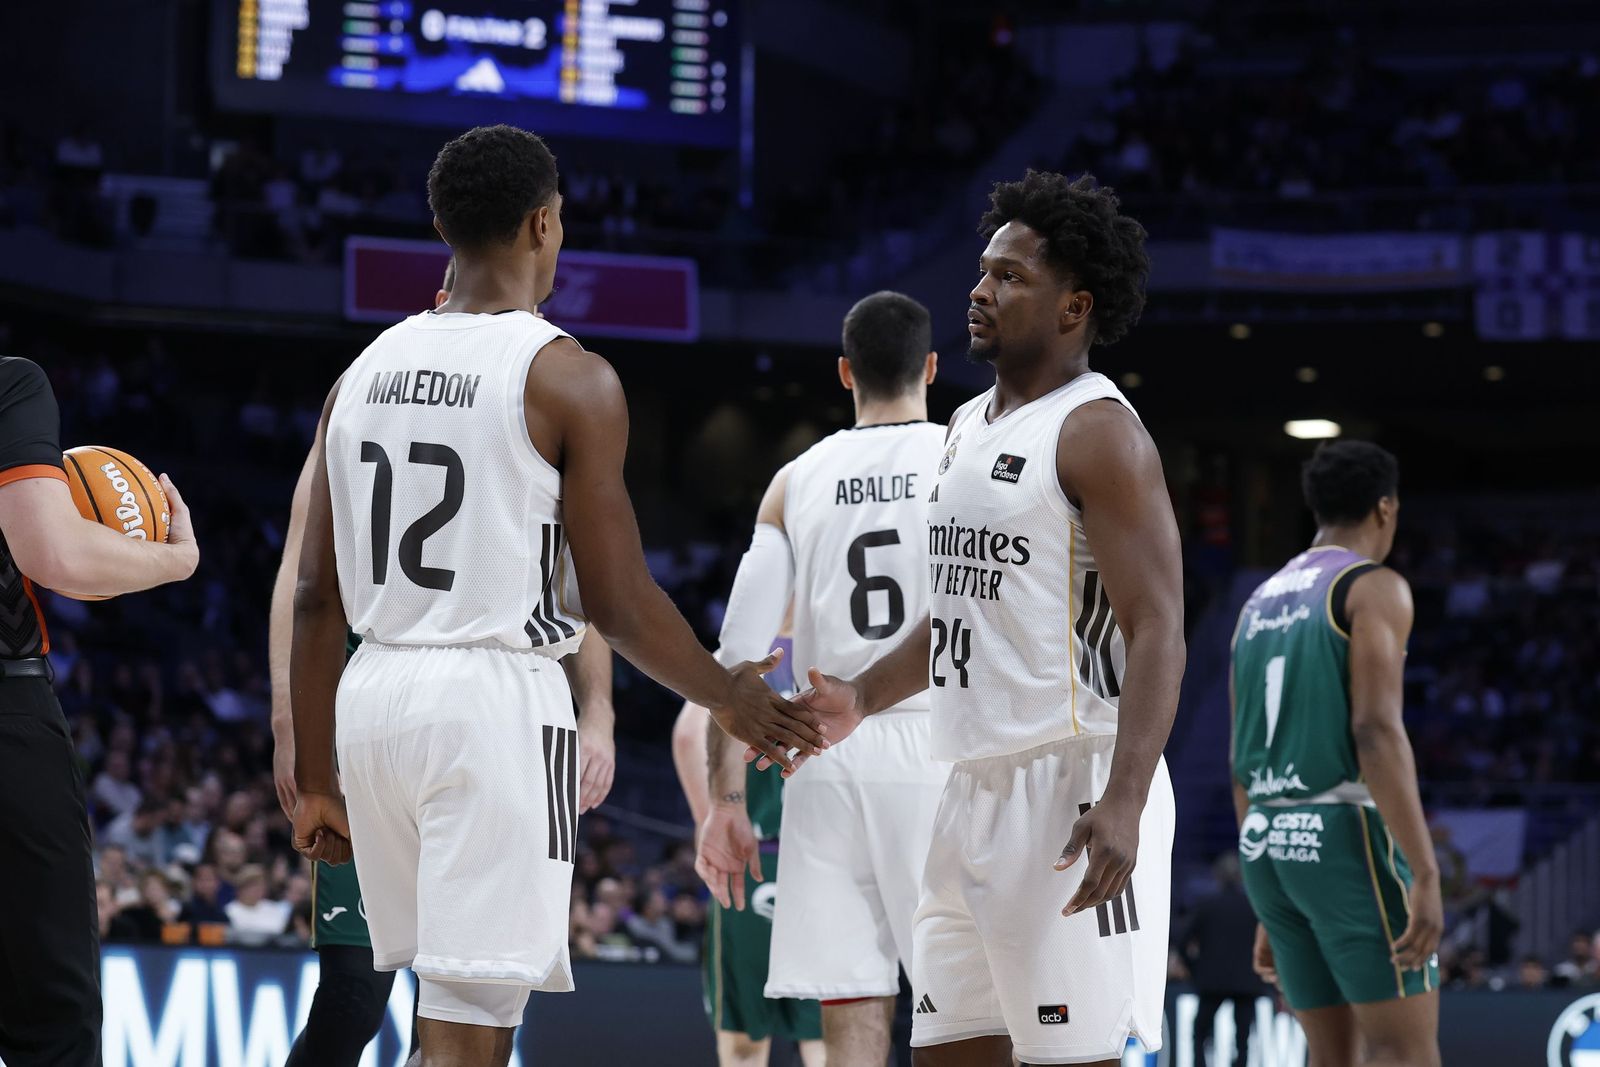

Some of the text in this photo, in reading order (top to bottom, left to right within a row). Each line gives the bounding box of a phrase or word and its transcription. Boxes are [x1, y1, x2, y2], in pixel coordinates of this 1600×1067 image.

[366, 370, 482, 409] MALEDON
[835, 474, 918, 505] ABALDE
[361, 441, 465, 592] 12
[927, 516, 1031, 566] mirates
[847, 529, 905, 641] 6
[945, 564, 1003, 601] BETTER
[932, 618, 972, 689] 24
[1265, 656, 1286, 749] 1
[1289, 831, 1323, 848] SOL
[102, 953, 321, 1067] MW
[1041, 1012, 1062, 1023] acb
